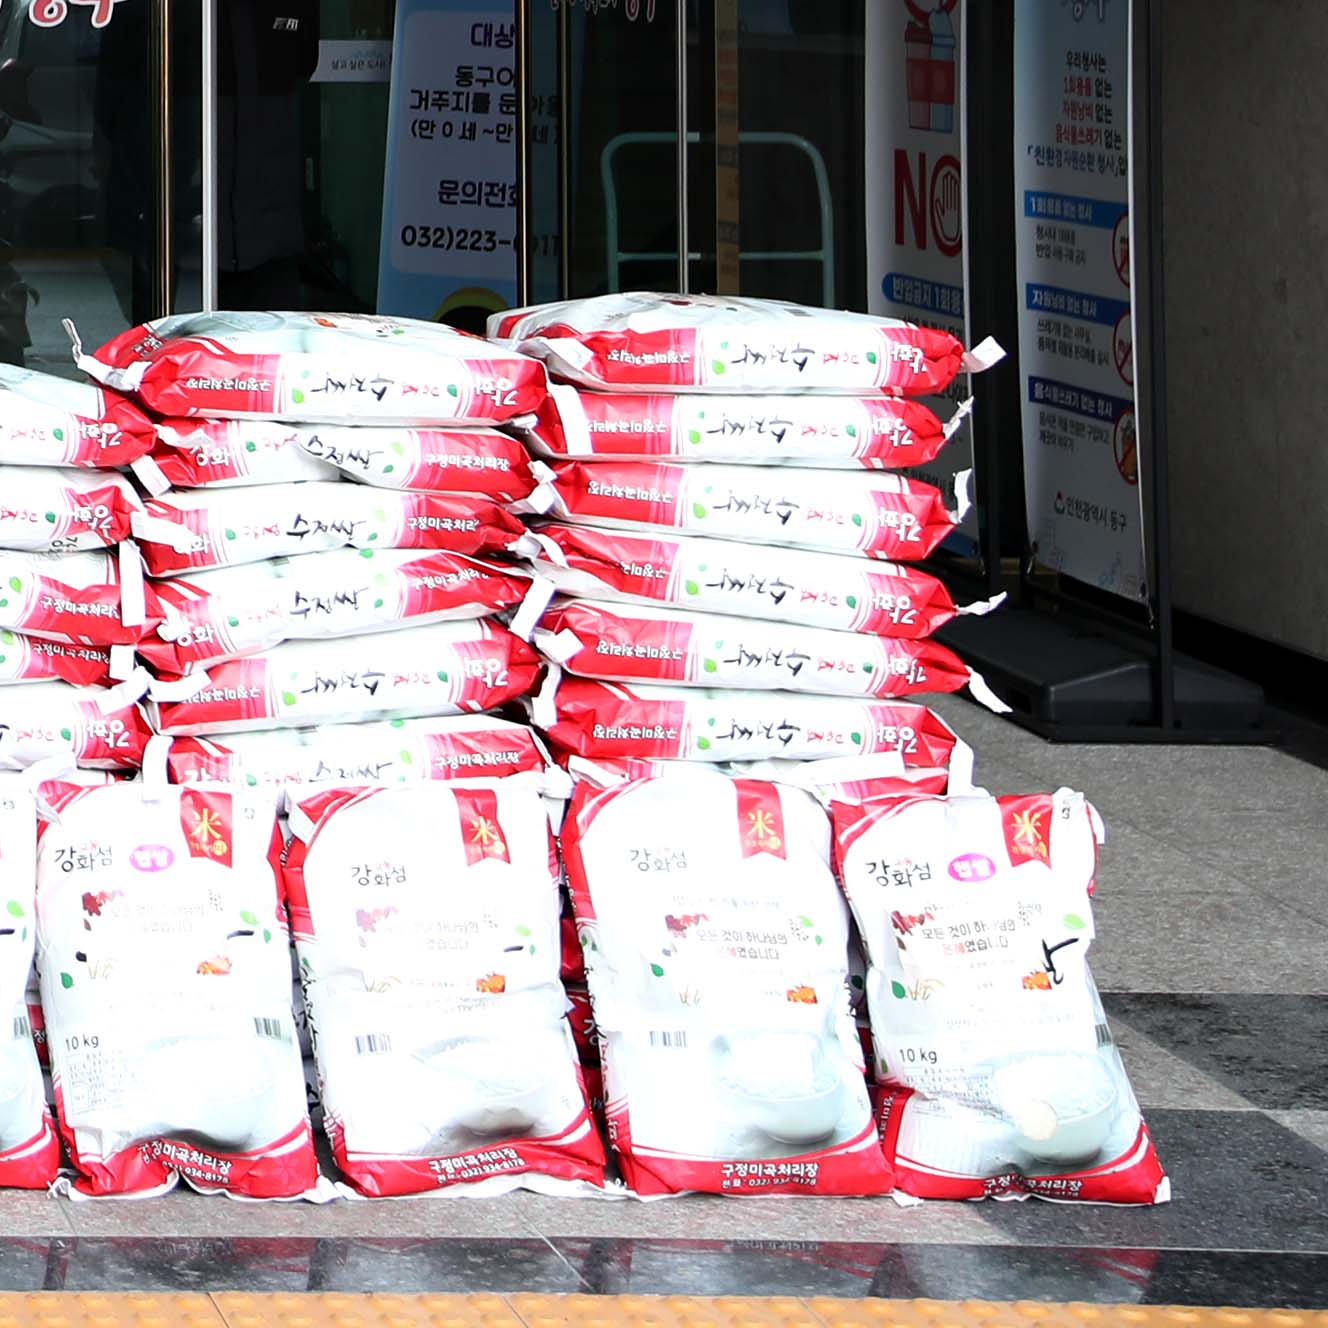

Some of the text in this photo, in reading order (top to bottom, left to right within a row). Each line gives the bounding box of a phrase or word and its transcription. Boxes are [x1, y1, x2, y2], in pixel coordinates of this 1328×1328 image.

[1095, 77, 1112, 98] 없는
[410, 90, 490, 114] 거주지를
[1095, 102, 1112, 124] 없는
[459, 121, 476, 142] 세
[731, 343, 816, 373] 수정쌀
[320, 377, 407, 407] 수정쌀
[438, 461, 526, 479] 구정미곡처리장
[713, 492, 800, 526] 수정쌀
[1111, 511, 1127, 532] 동구
[722, 644, 811, 677] 수정쌀
[716, 719, 801, 747] 수정쌀
[192, 808, 222, 842] 米
[1012, 810, 1043, 844] 米
[54, 844, 114, 874] 강화섬
[629, 848, 689, 874] 강화섬
[351, 863, 407, 888] 강화섬
[866, 860, 933, 890] 강화섬
[65, 1034, 99, 1051] 10 kg
[898, 1048, 938, 1066] 10 kg
[722, 1161, 819, 1178] 구정미곡처리장
